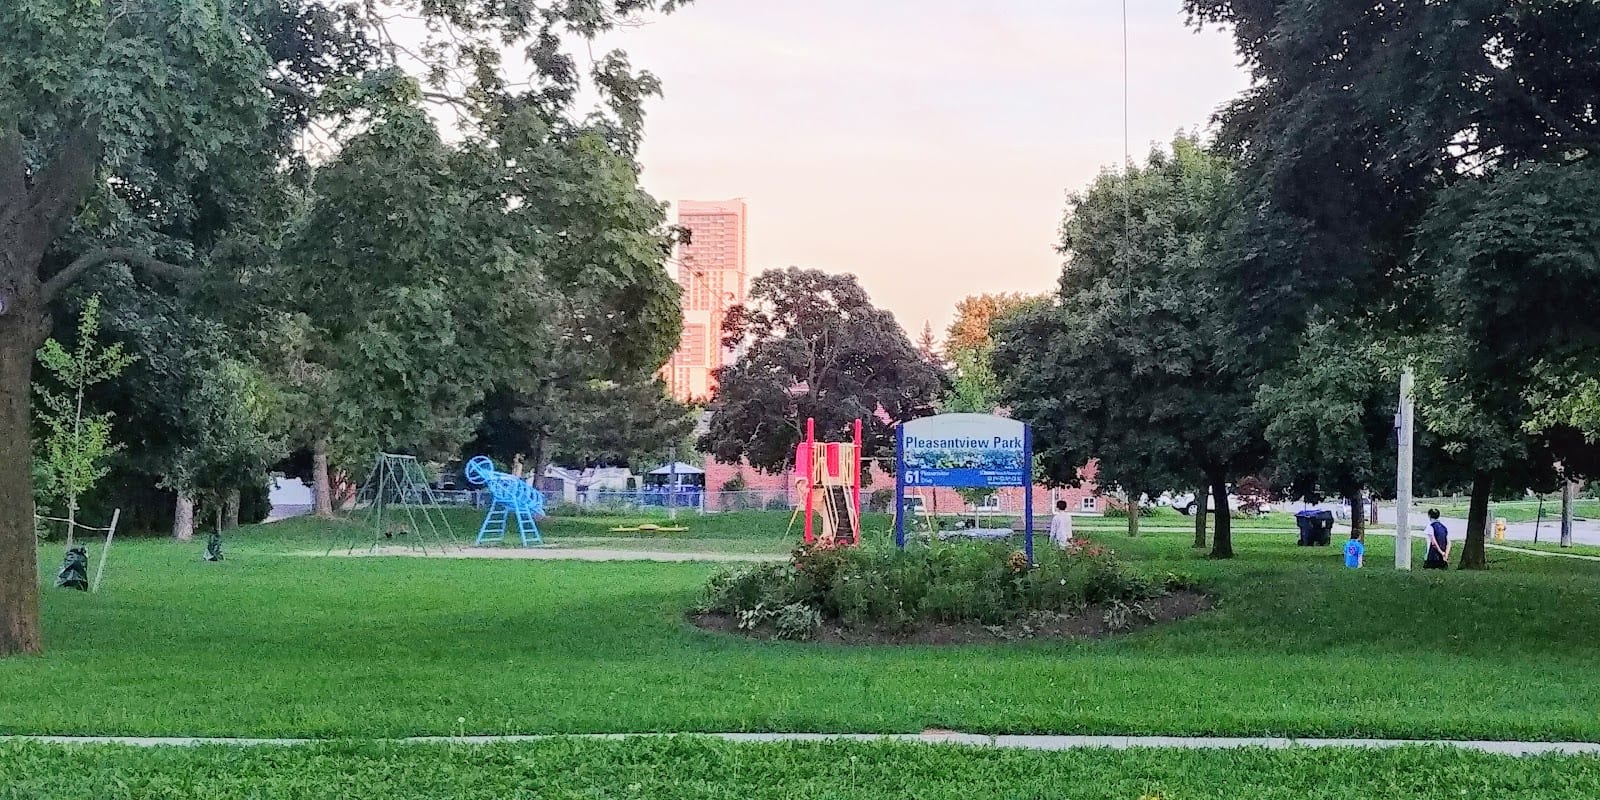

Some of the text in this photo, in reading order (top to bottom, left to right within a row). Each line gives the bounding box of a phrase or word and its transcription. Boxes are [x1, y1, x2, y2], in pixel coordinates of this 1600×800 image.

[905, 436, 1021, 449] Pleasantview Park
[904, 470, 920, 484] 61
